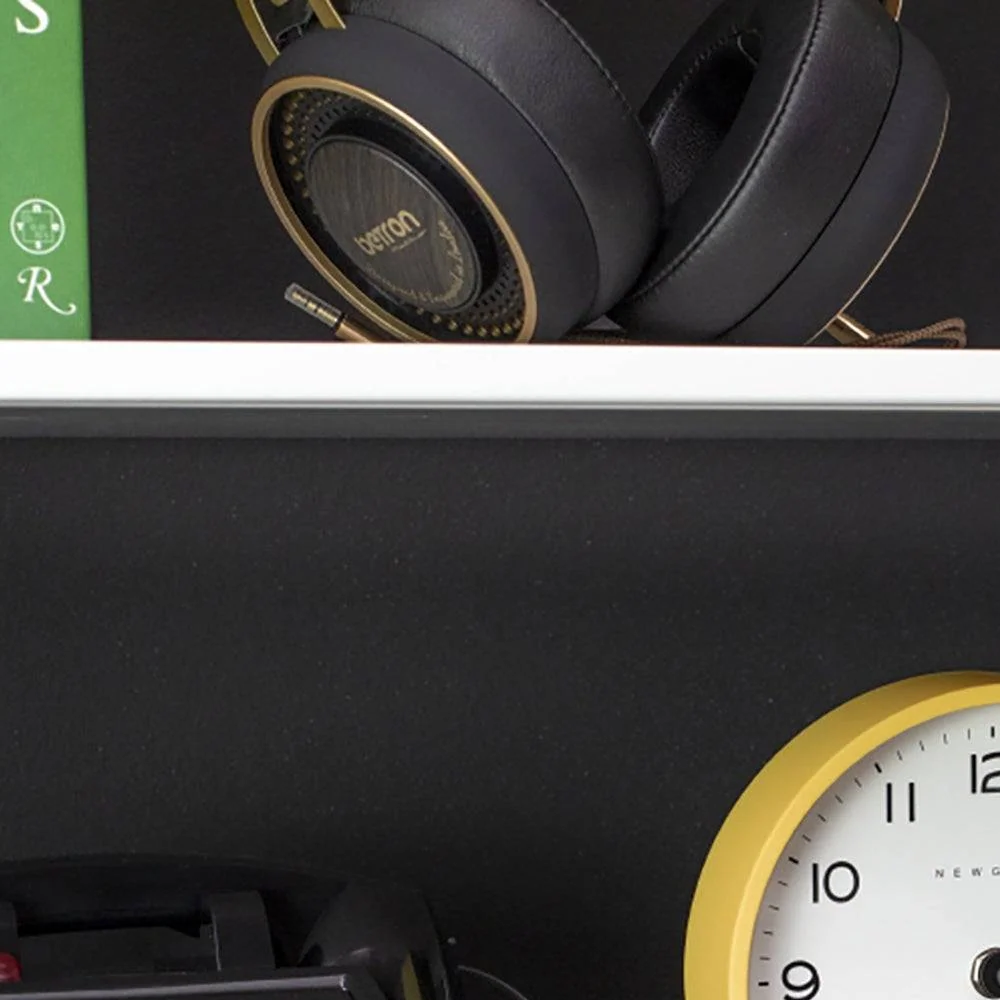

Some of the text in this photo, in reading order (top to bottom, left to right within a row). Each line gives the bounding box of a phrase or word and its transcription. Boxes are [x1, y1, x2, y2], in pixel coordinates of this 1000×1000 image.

[17, 266, 77, 315] R
[886, 781, 916, 824] 11
[811, 860, 860, 904] 10
